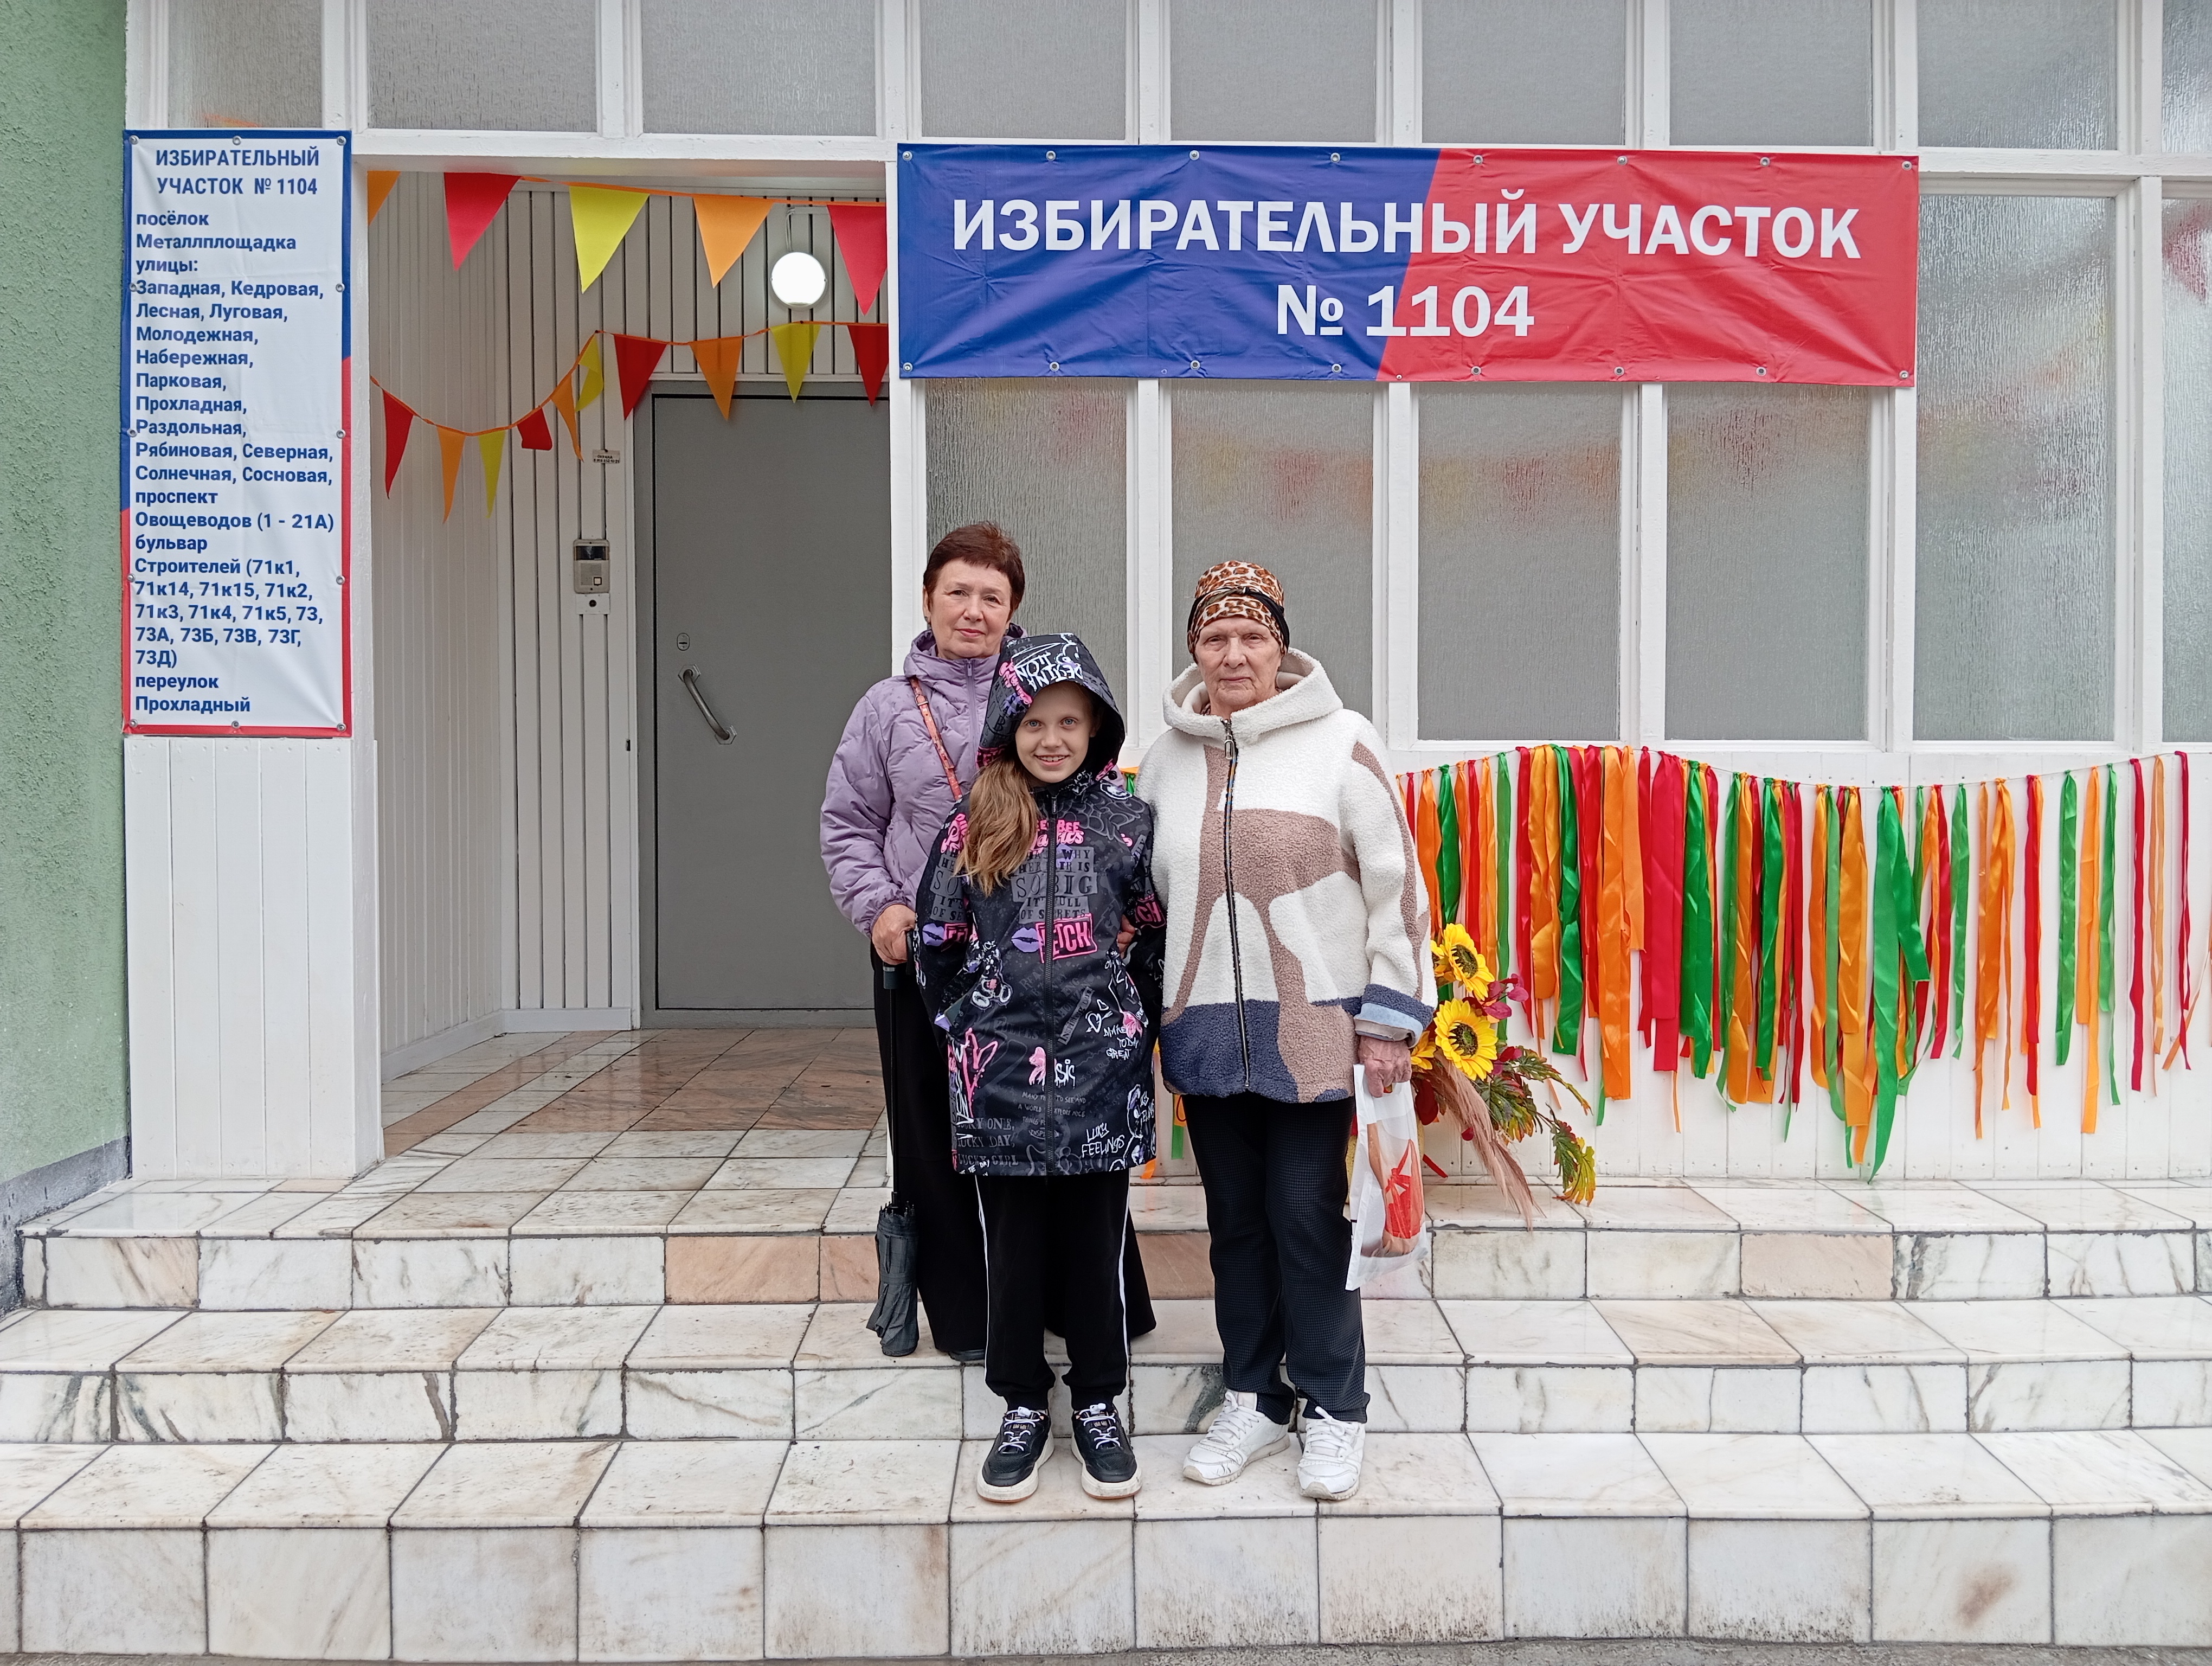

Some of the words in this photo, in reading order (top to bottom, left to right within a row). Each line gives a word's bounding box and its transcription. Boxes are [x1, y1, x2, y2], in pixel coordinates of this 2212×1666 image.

[156, 146, 319, 166] ИЗБИРАТЕЛЬНЫЙ
[157, 177, 243, 195] УЧАСТОК
[254, 178, 272, 194] №
[277, 178, 317, 195] 1104
[136, 210, 209, 226] посёлок
[954, 189, 1536, 254] ИЗБИРАТЕЛЬНЫЙ
[1558, 203, 1861, 259] УЧАСТОК
[136, 233, 296, 252] Металлплощадка
[136, 260, 198, 275] улицы:
[136, 279, 225, 299] Западная,
[231, 280, 323, 299] Кедровая,
[136, 303, 204, 322] Лесная,
[209, 303, 287, 323] Луговая,
[1277, 284, 1343, 336] №
[1366, 285, 1534, 337] 1104
[136, 326, 258, 345] Молодежная,
[136, 348, 253, 368] Набережная,
[136, 373, 226, 392] Парковая,
[136, 396, 247, 415] Прохладная,
[136, 419, 246, 438] Раздольная,
[136, 441, 237, 462] Рябиновая,
[242, 443, 333, 463] Северная,
[136, 465, 236, 484] Солнечная,
[242, 466, 332, 486] Сосновая,
[136, 492, 218, 507] проспект
[135, 511, 252, 530] Овощеводов
[257, 512, 271, 532] (1
[292, 513, 334, 533] 21А)
[135, 534, 208, 554] бульвар
[134, 558, 241, 576] Строителей
[246, 558, 300, 578] (71к1,
[134, 581, 194, 599] 71к14,
[199, 581, 259, 600] 71к15,
[265, 582, 312, 601] 71к2,
[135, 604, 183, 623] 71к3,
[188, 604, 236, 623] 71к4,
[242, 605, 291, 624] 71к5,
[296, 606, 323, 625] 73,
[135, 626, 174, 645] 73А,
[180, 627, 218, 646] 73Б,
[223, 628, 261, 646] 73В,
[269, 628, 301, 648] 73Г,
[135, 649, 177, 669] 73Д)
[136, 676, 219, 692] переулок
[136, 696, 250, 715] Прохладный
[1061, 849, 1091, 860] WHY
[1078, 861, 1090, 873] IS
[1015, 874, 1040, 899] SO
[1056, 896, 1081, 907] ULL
[1020, 909, 1034, 920] OF
[1105, 1047, 1132, 1061] GREAT
